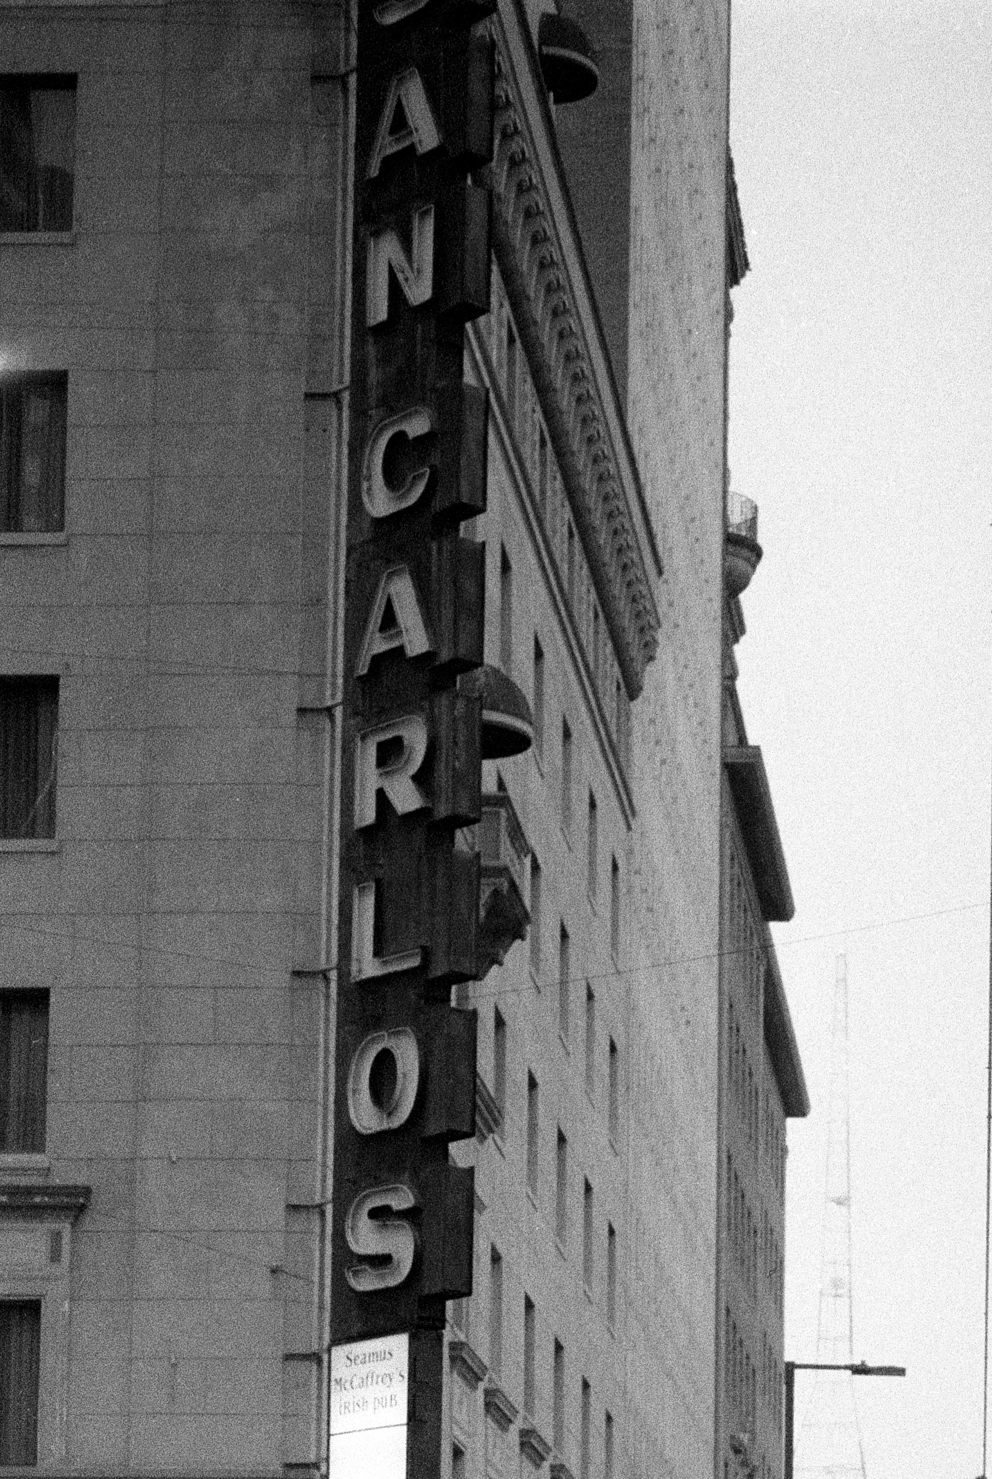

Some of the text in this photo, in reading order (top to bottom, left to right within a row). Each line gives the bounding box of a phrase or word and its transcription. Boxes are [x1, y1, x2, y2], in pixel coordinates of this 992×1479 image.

[346, 0, 443, 1293] AN CARLOS
[345, 1350, 393, 1368] Seamus
